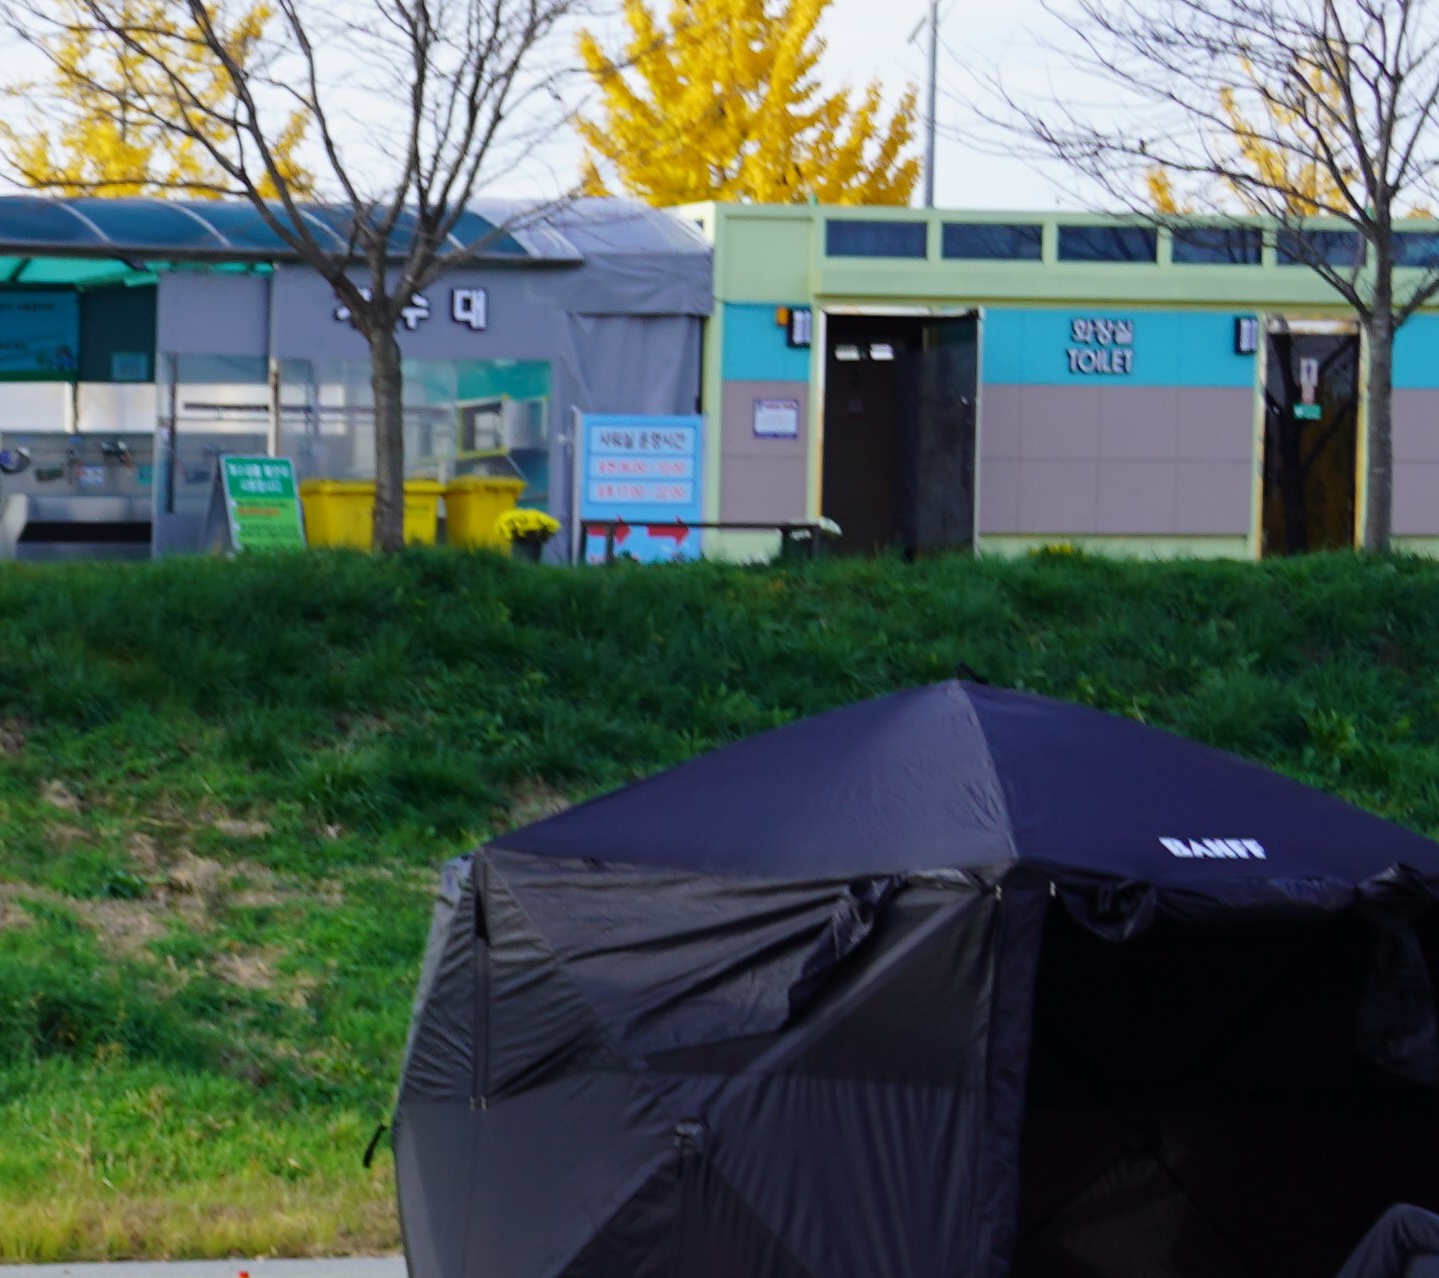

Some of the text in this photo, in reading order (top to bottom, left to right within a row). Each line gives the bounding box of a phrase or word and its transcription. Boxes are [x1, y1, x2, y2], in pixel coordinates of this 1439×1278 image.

[1071, 318, 1133, 346] 화장실
[1065, 347, 1133, 374] TOILET
[1158, 836, 1267, 860] BANFF
